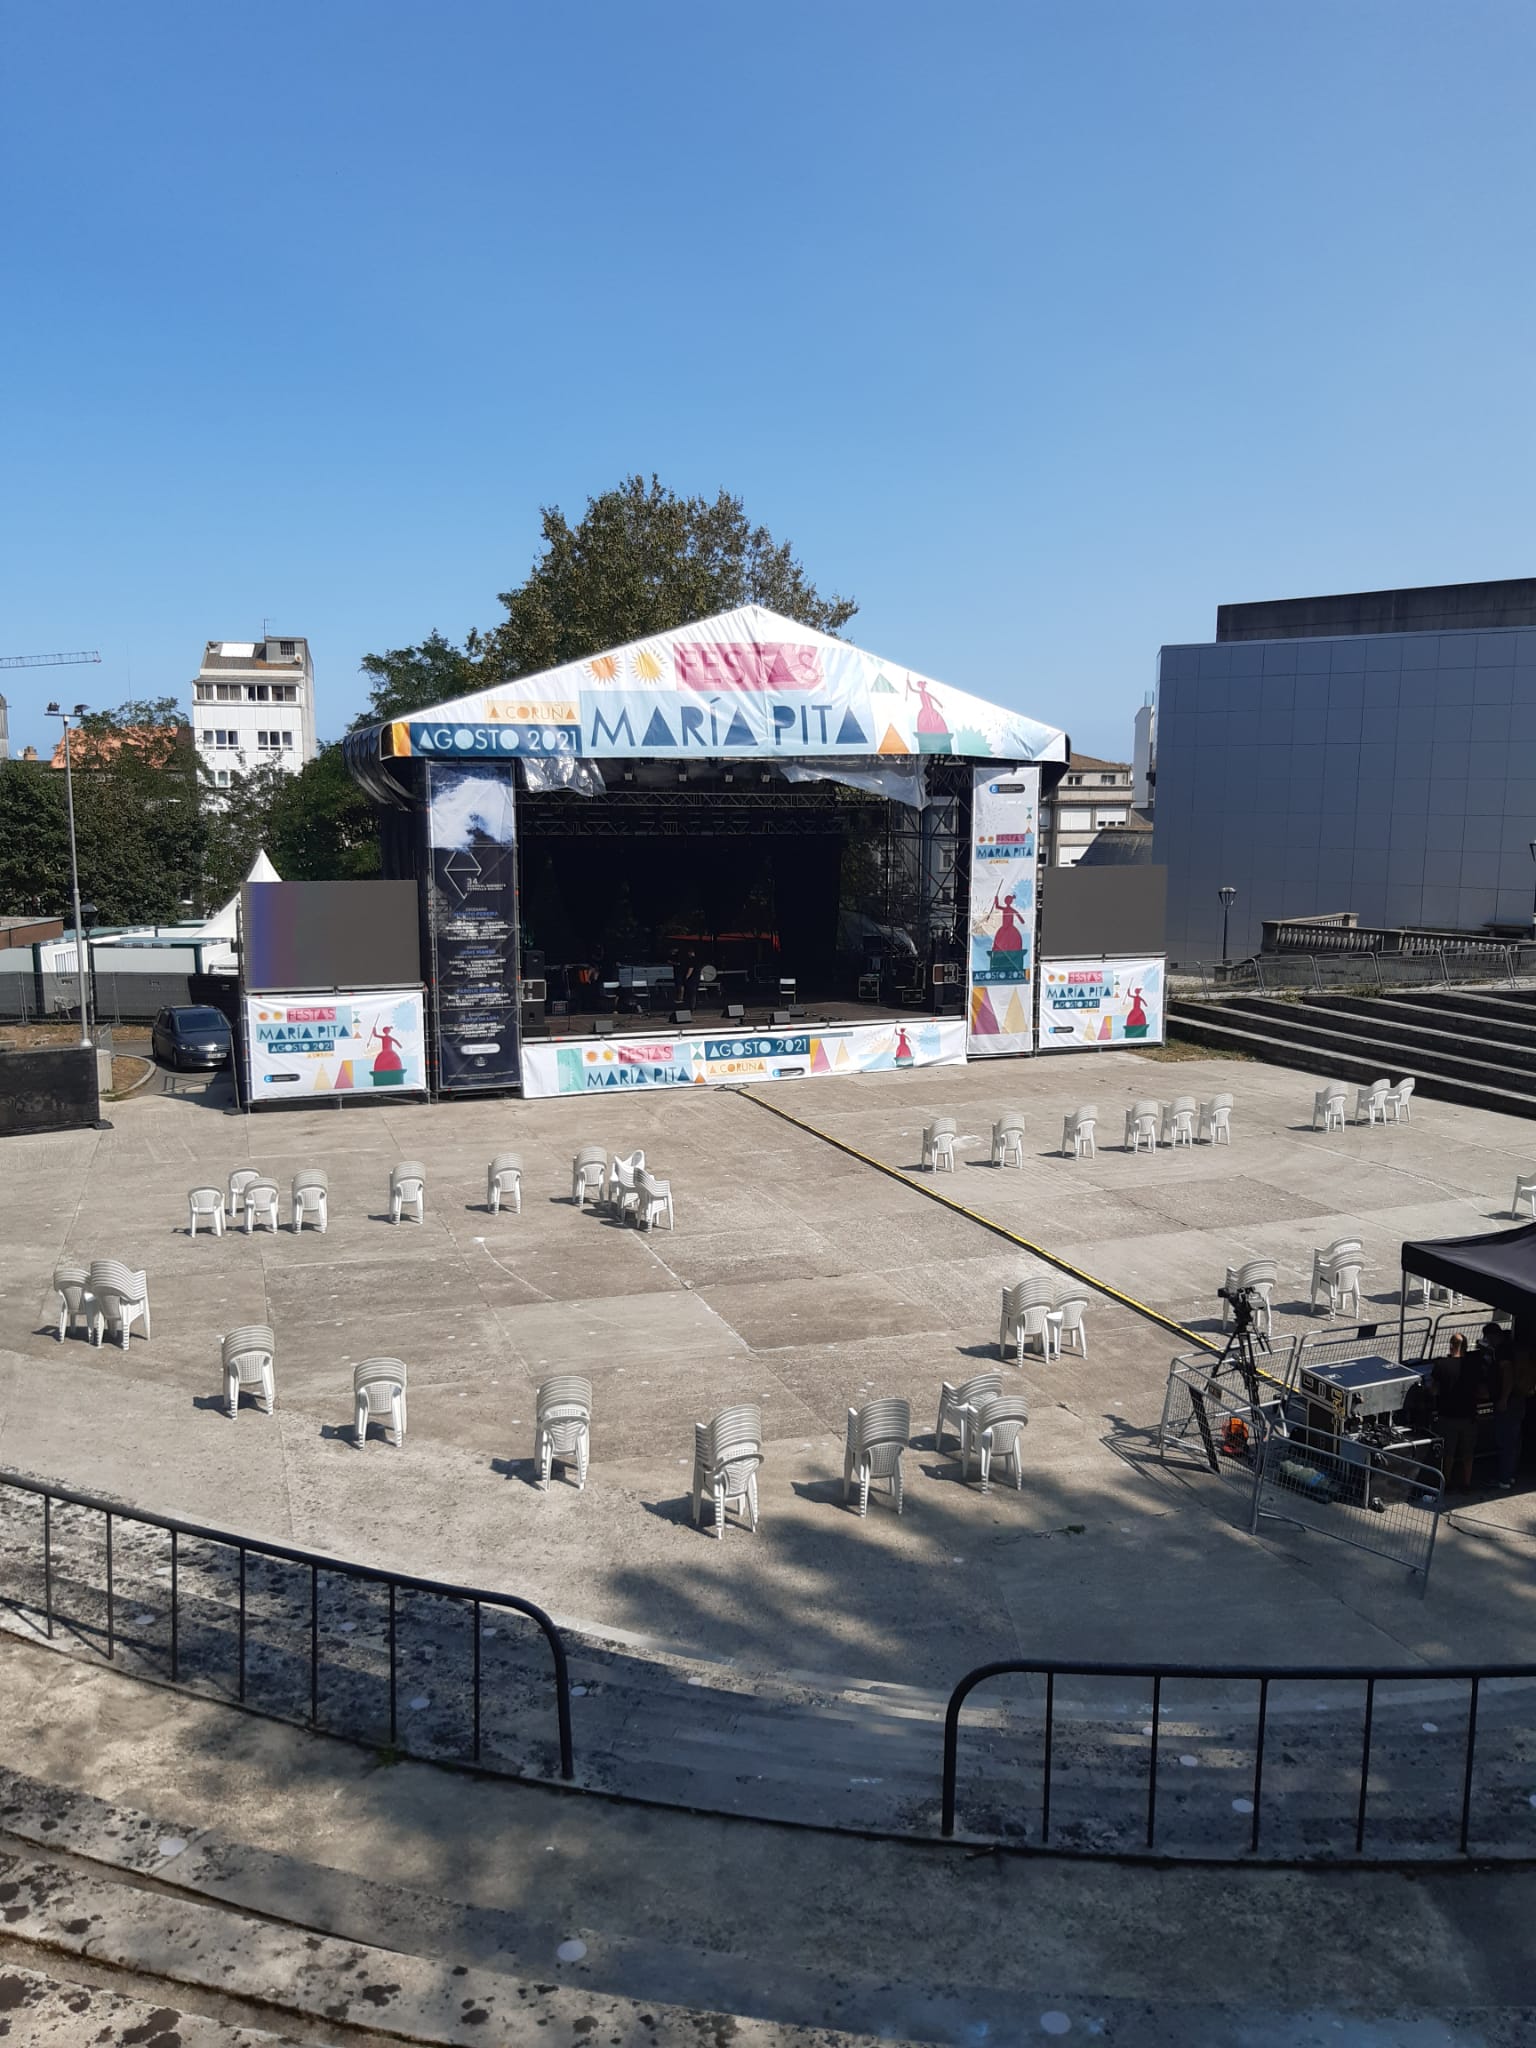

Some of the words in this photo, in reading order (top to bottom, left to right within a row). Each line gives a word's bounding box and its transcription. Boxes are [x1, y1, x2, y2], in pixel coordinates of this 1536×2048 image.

[680, 649, 822, 684] FESTAS
[489, 705, 499, 718] A
[505, 703, 576, 719] CORUÑA
[591, 697, 759, 747] MARÍA
[773, 705, 869, 746] PITA
[418, 728, 519, 750] AGOSTO
[527, 730, 578, 750] 2021
[1013, 847, 1032, 857] PITA
[974, 971, 1006, 980] AGOSTO
[1068, 972, 1102, 983] FESTAS
[1089, 986, 1111, 997] PITA
[1054, 1001, 1083, 1009] AGOSTO
[287, 1008, 335, 1021] FESTAS
[260, 1024, 313, 1040] MARÍA
[318, 1025, 350, 1038] PITA
[271, 1043, 310, 1052] AGOSTO
[313, 1041, 333, 1051] 2021
[709, 1041, 771, 1057] AGOSTO
[776, 1038, 807, 1053] 2021
[619, 1046, 672, 1063] FESTAS
[710, 1064, 717, 1073] A
[587, 1065, 648, 1087] MARÍA
[654, 1066, 690, 1082] PITA
